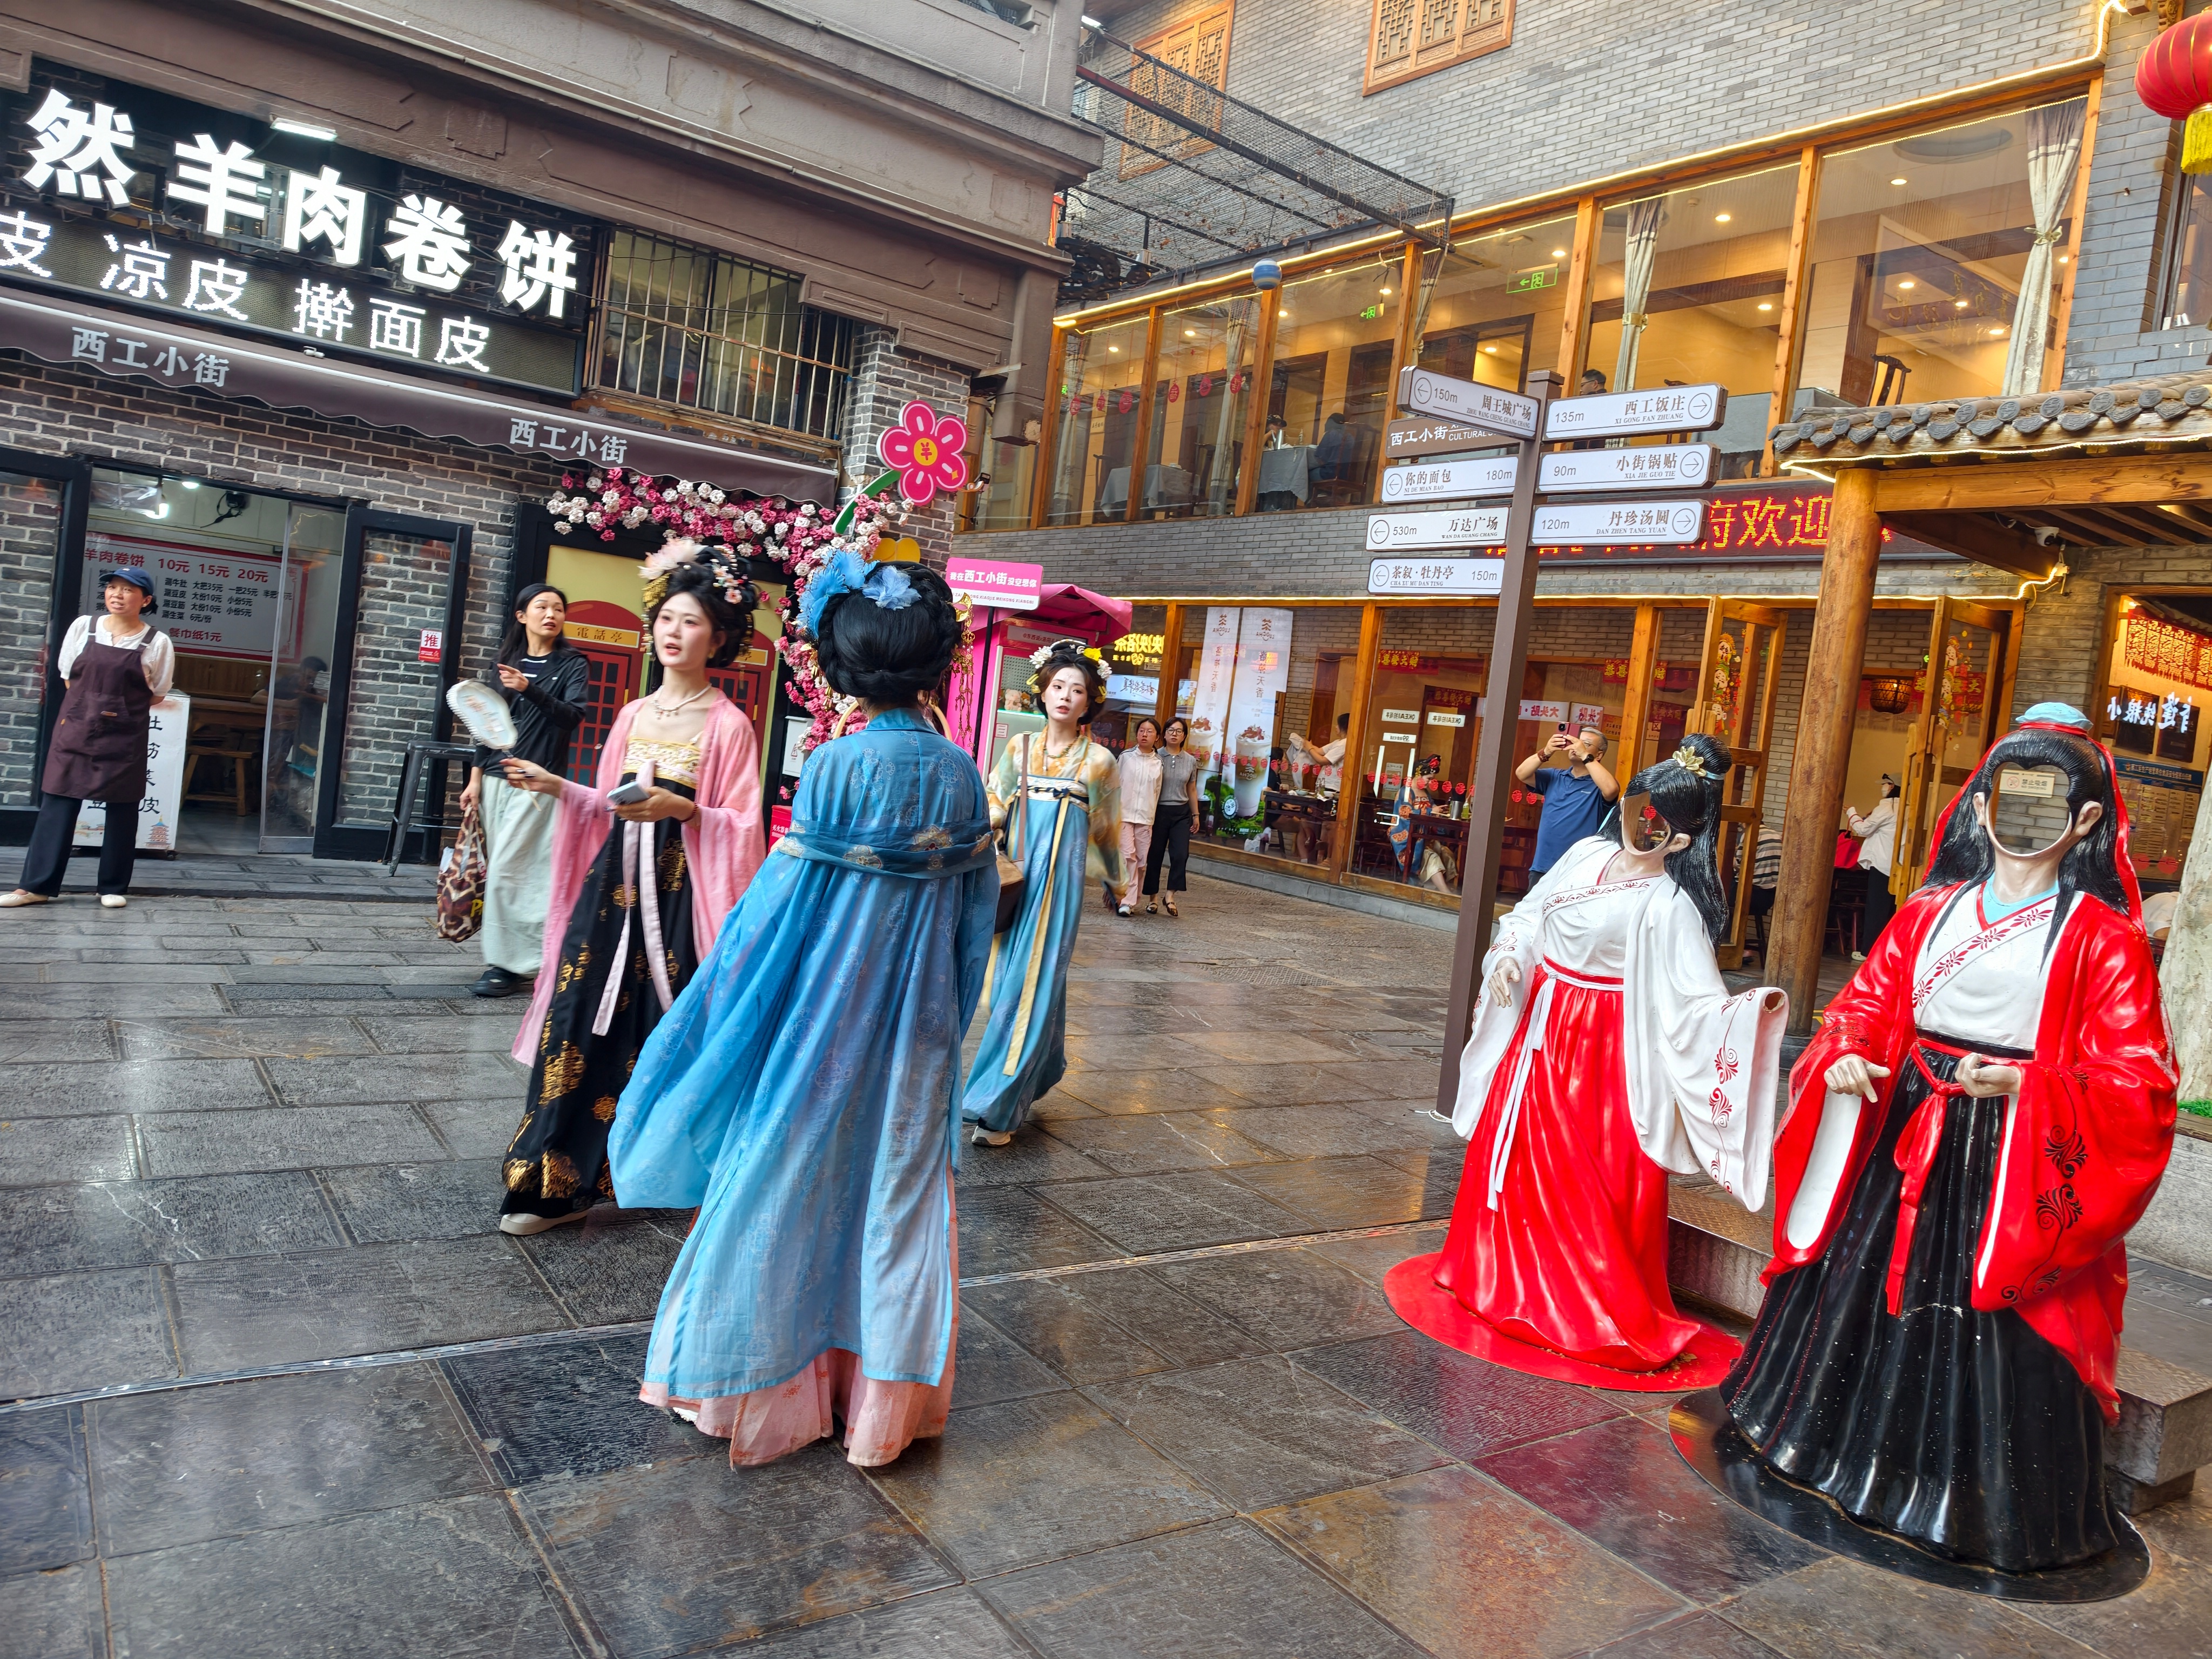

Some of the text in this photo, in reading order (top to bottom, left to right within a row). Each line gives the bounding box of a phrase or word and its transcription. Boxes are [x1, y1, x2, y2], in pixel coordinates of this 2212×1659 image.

[22, 87, 577, 319] 然羊肉卷饼
[100, 233, 248, 321] 凉皮
[292, 278, 490, 373] 擀面皮
[72, 327, 230, 387] 西工小街
[1434, 387, 1458, 403] 150m
[1481, 394, 1532, 421] 周王城广场
[1624, 395, 1686, 416] 西工饭庄
[1467, 407, 1478, 415] ZHOU
[1490, 414, 1503, 422] CHENG
[1503, 417, 1518, 425] GUANG
[1518, 420, 1530, 428] CHANG
[1555, 412, 1584, 423] 135m
[1657, 413, 1684, 421] ZHUANG
[509, 418, 628, 464] 西工小街
[1390, 426, 1448, 446] 西工小街
[1448, 430, 1487, 441] CULTURAL
[1616, 453, 1678, 471] 小街锅贴
[1405, 469, 1452, 486] 你的面包
[1486, 469, 1512, 481] 180m
[1554, 466, 1576, 476] 90m
[1448, 516, 1498, 532] 万达广场
[1541, 517, 1570, 530] 120m
[1608, 508, 1669, 528] 丹珍汤圆
[1393, 527, 1417, 535] 530m
[85, 548, 269, 583] 羊肉卷饼 10元 15元 20元
[950, 570, 1037, 588] 我在西工小街没空想你
[1472, 571, 1498, 581] 150m
[168, 628, 222, 642] 餐巾纸1元
[424, 633, 439, 647] 推
